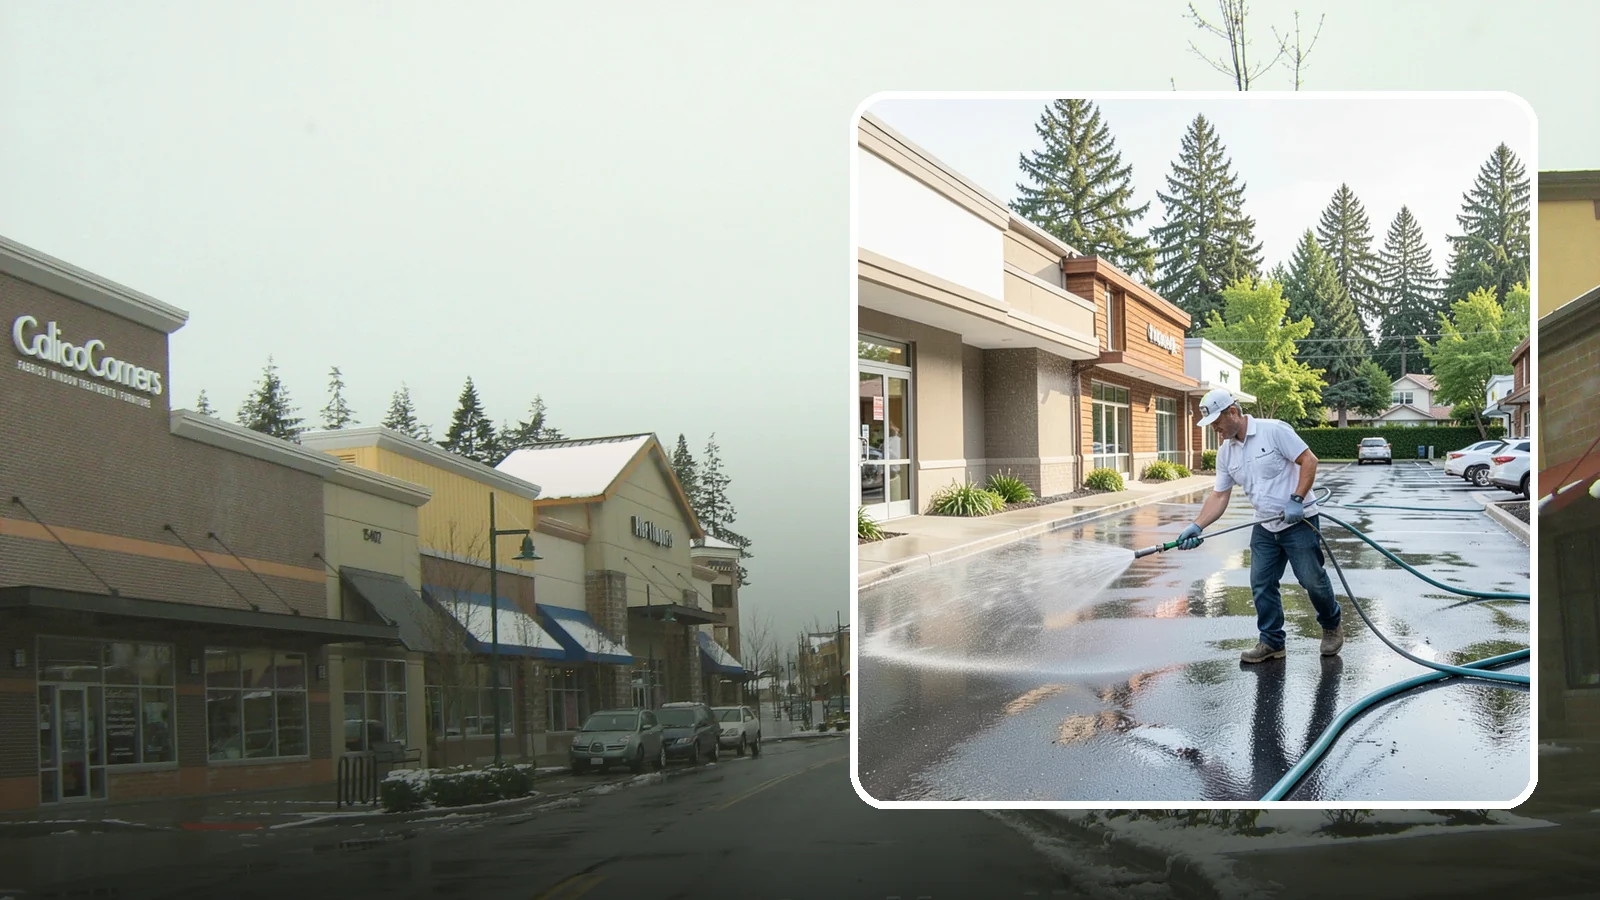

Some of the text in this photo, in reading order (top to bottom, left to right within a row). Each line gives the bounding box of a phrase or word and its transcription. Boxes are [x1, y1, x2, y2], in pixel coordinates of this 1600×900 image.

[16, 360, 151, 408] FABRICS WINDOW TREATMENTS FURNITURE
